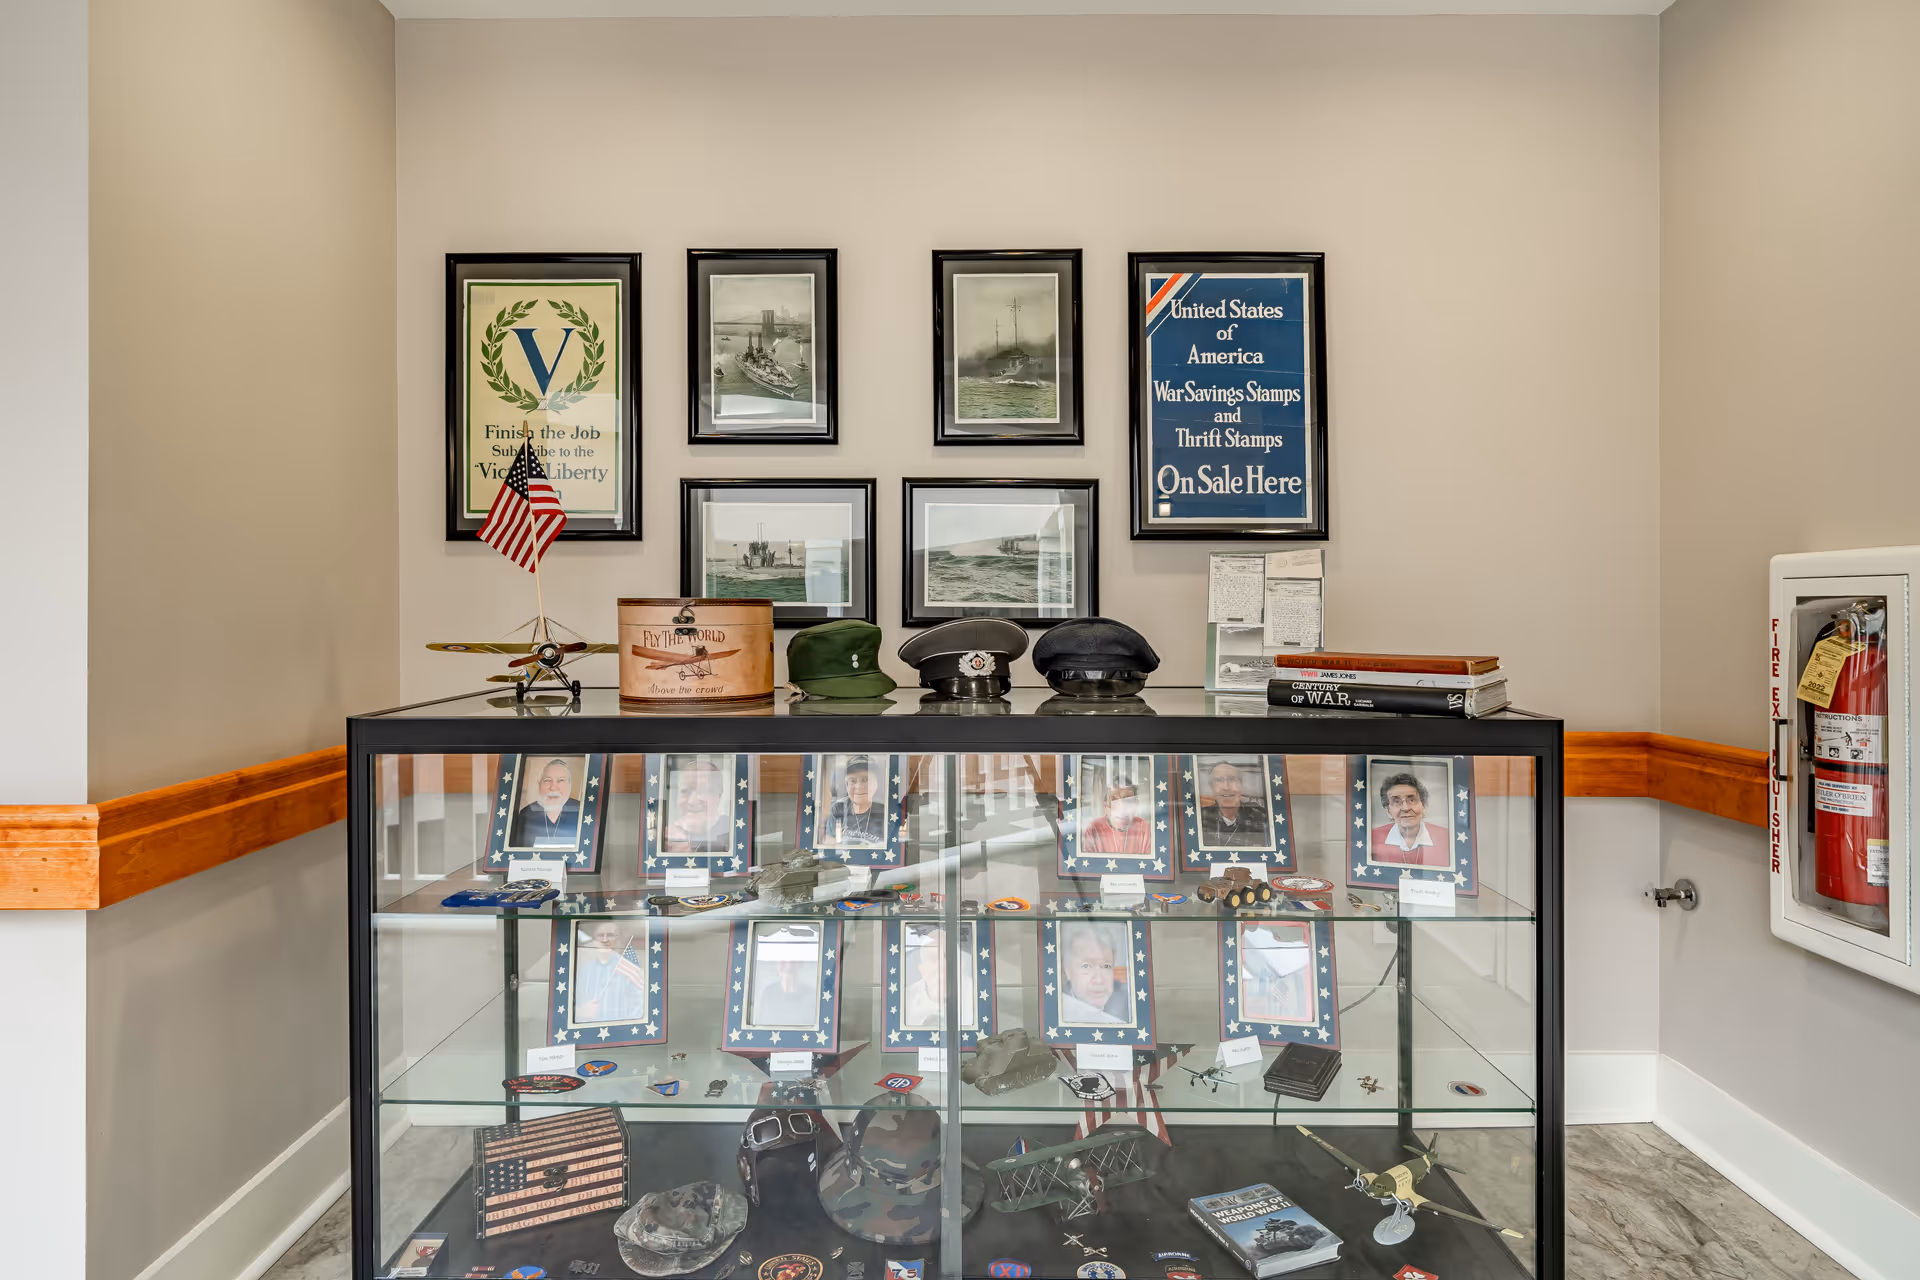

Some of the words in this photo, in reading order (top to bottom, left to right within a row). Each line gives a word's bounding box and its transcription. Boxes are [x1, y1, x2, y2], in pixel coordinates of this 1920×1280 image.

[1171, 299, 1227, 319] United
[1229, 299, 1283, 319] States
[1216, 324, 1238, 341] of
[507, 328, 577, 396] V
[1187, 344, 1265, 364] America
[1153, 380, 1184, 402] War
[1184, 380, 1244, 406] Savings
[1246, 380, 1301, 406] Stamps
[1214, 407, 1242, 423] and
[540, 425, 566, 439] the
[570, 425, 601, 439] Job
[1175, 427, 1222, 448] Thrift
[1225, 427, 1283, 454] Stamps
[559, 446, 571, 457] to
[574, 445, 594, 457] the
[546, 463, 608, 483] Liberty
[1157, 464, 1195, 494] On
[1198, 464, 1243, 494] Sale
[1246, 465, 1302, 494] Here
[643, 629, 661, 648] FLY
[662, 630, 684, 648] THE
[688, 629, 726, 643] WORLD
[1772, 618, 1780, 678] FIRE
[648, 683, 676, 695] Above
[679, 685, 692, 694] the
[695, 685, 724, 694] crowd
[1291, 682, 1341, 692] CENTURY
[1807, 681, 1826, 692] 2022
[1291, 695, 1304, 704] OF
[1305, 691, 1351, 706] WAR
[1212, 1200, 1268, 1218] WEAPONS
[1270, 1195, 1284, 1204] OF
[1218, 1212, 1256, 1224] WORLD
[1255, 1204, 1280, 1216] WAR
[1280, 1201, 1292, 1210] II
